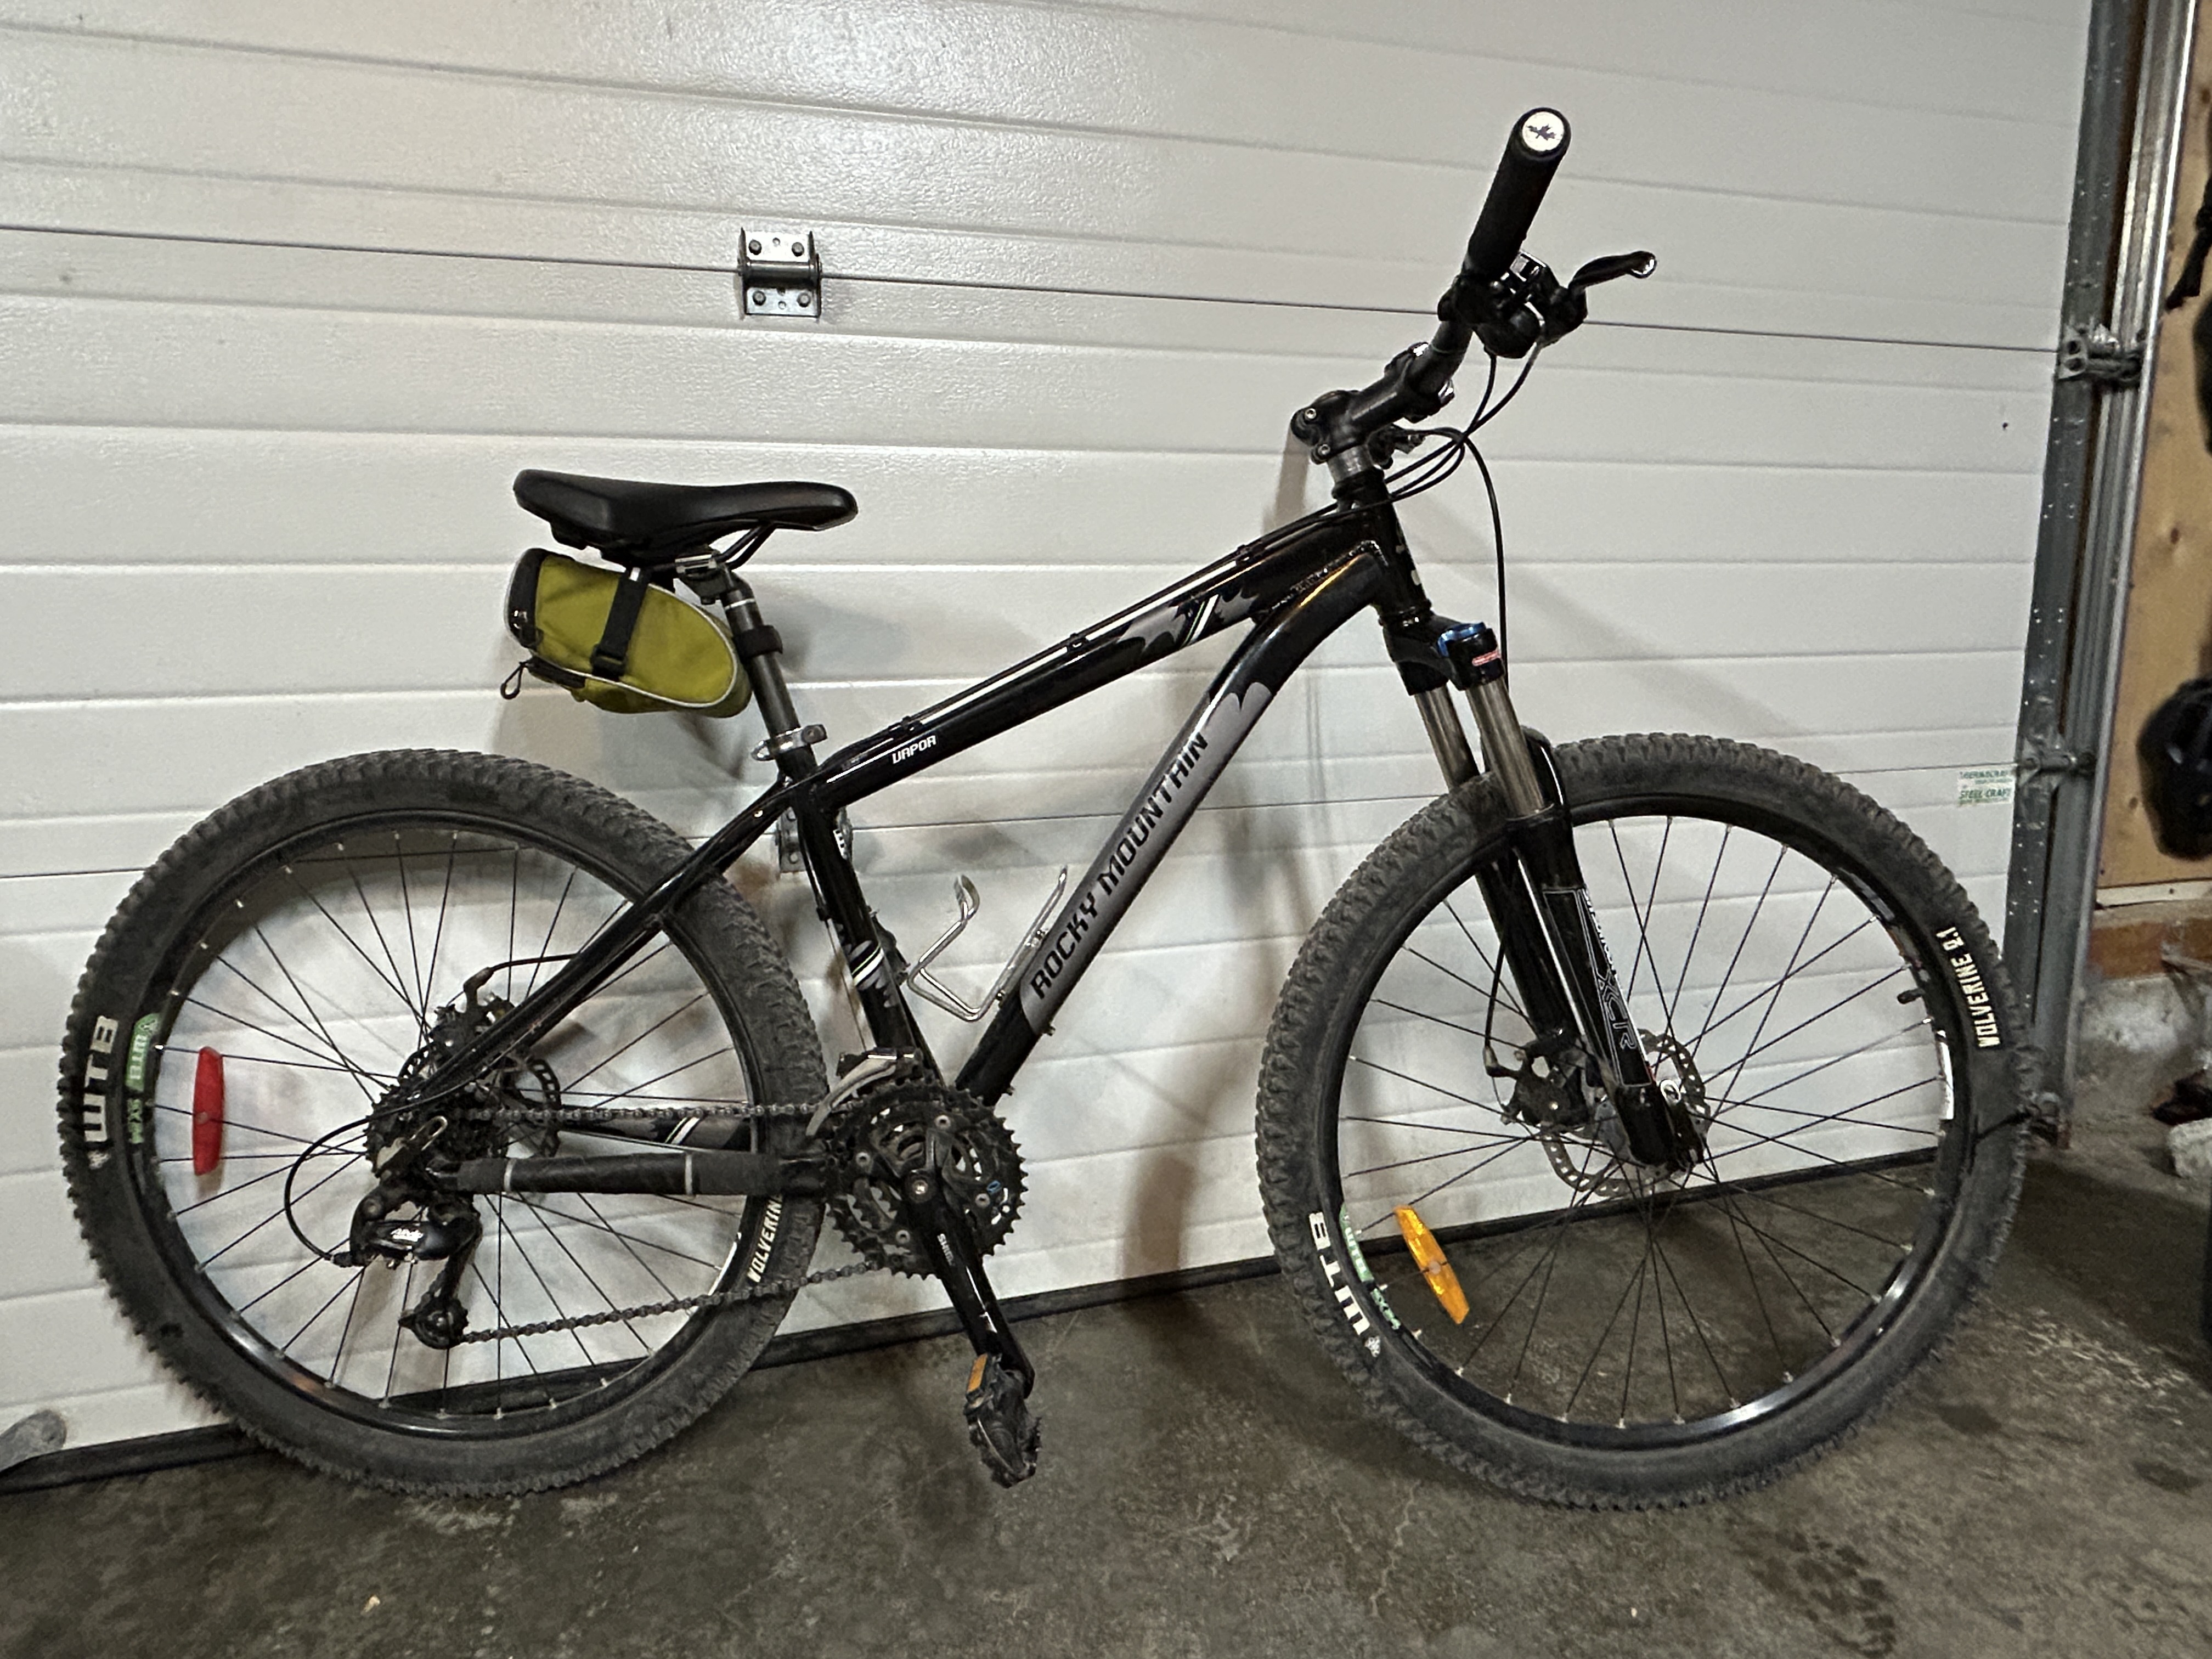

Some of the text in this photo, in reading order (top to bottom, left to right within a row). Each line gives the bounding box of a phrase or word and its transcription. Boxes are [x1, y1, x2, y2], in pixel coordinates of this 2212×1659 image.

[892, 735, 936, 764] VAPOR
[1030, 732, 1208, 1000] ROCKY MOUNTAIN
[1936, 927, 2001, 1047] WOLVERINE 2.1
[83, 1015, 118, 1142] WTB
[1309, 1212, 1370, 1335] WTB
